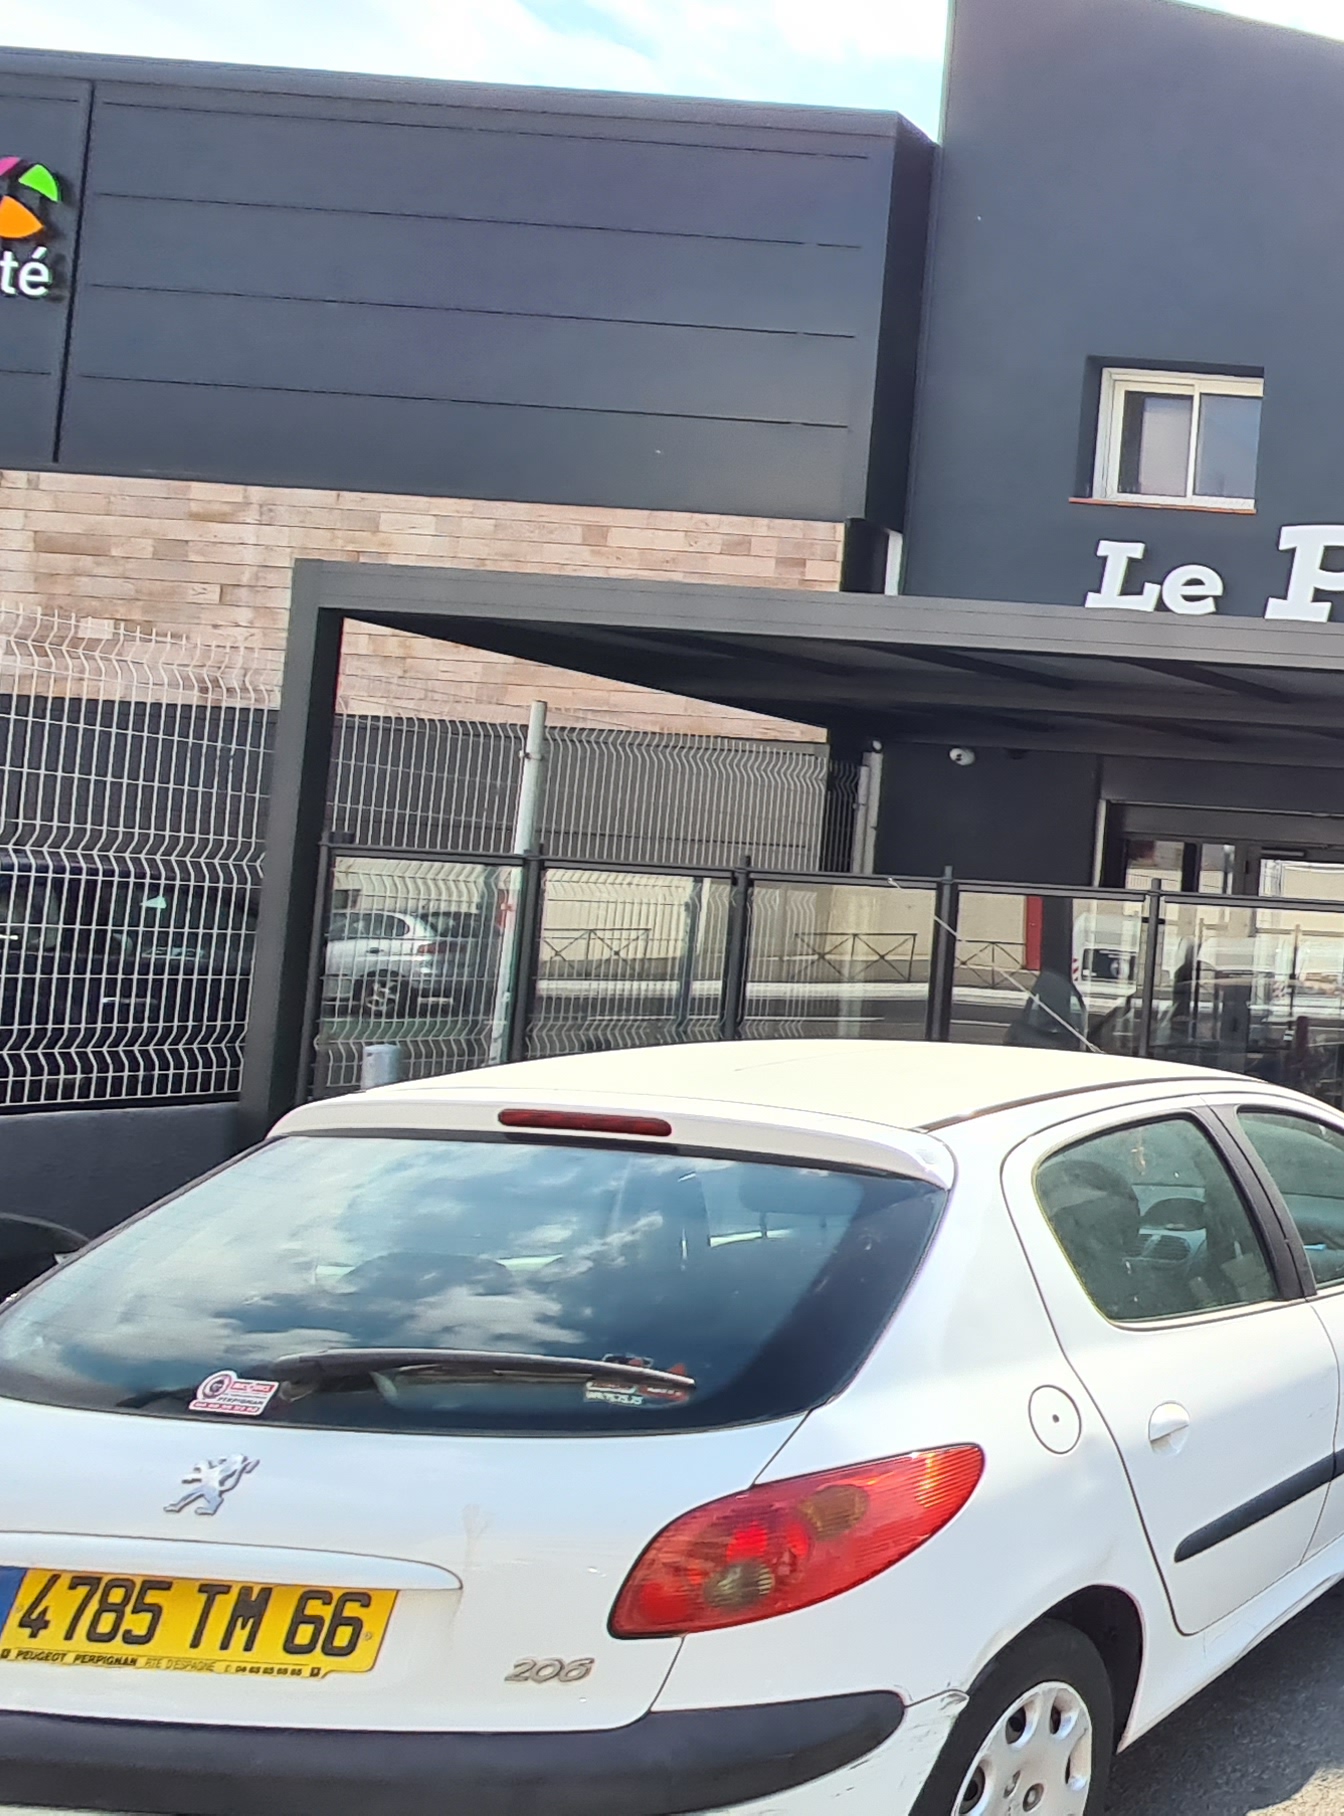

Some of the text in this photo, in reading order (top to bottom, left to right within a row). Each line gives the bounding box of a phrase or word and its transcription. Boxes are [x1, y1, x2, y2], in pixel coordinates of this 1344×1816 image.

[1084, 540, 1223, 615] Le
[18, 1573, 372, 1657] 4785 TM 66
[15, 1650, 67, 1662] PEUGEOT
[73, 1653, 138, 1667] PERPIGNAN
[504, 1657, 595, 1684] 206
